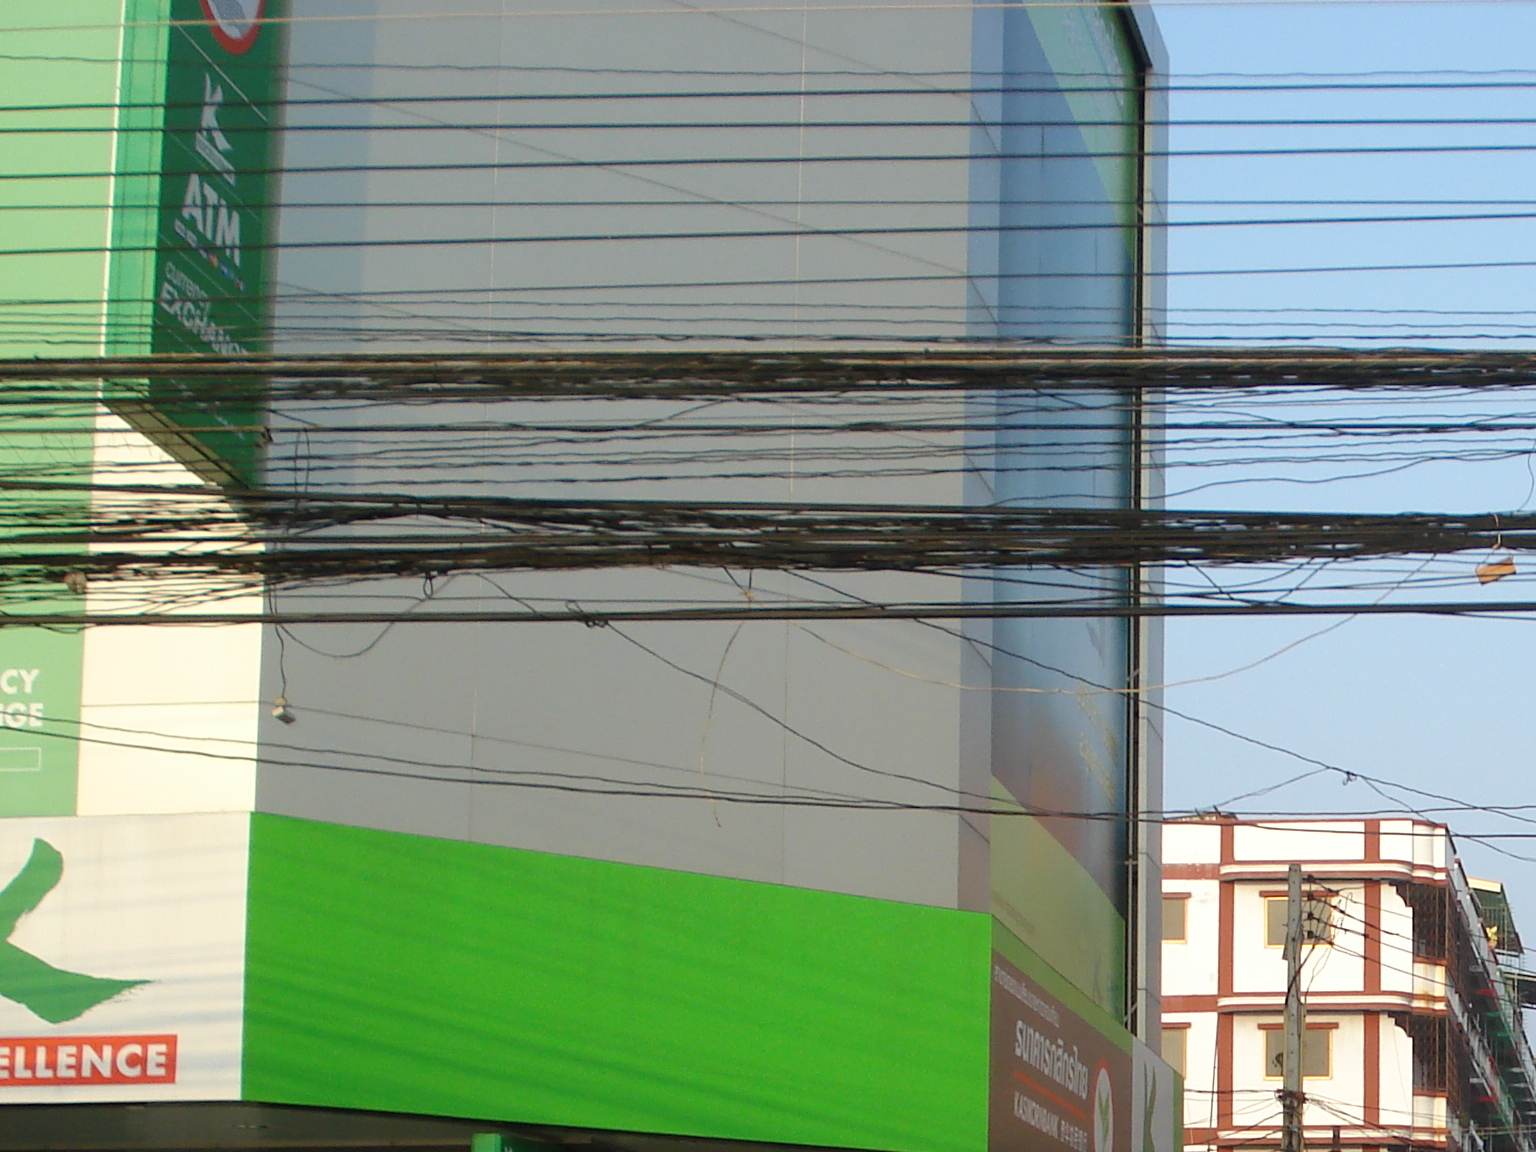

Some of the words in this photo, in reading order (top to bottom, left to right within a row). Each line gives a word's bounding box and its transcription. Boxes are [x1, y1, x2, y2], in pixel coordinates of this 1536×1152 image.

[182, 173, 242, 267] ATM
[159, 282, 250, 356] EXCHANG
[0, 701, 44, 729] GE
